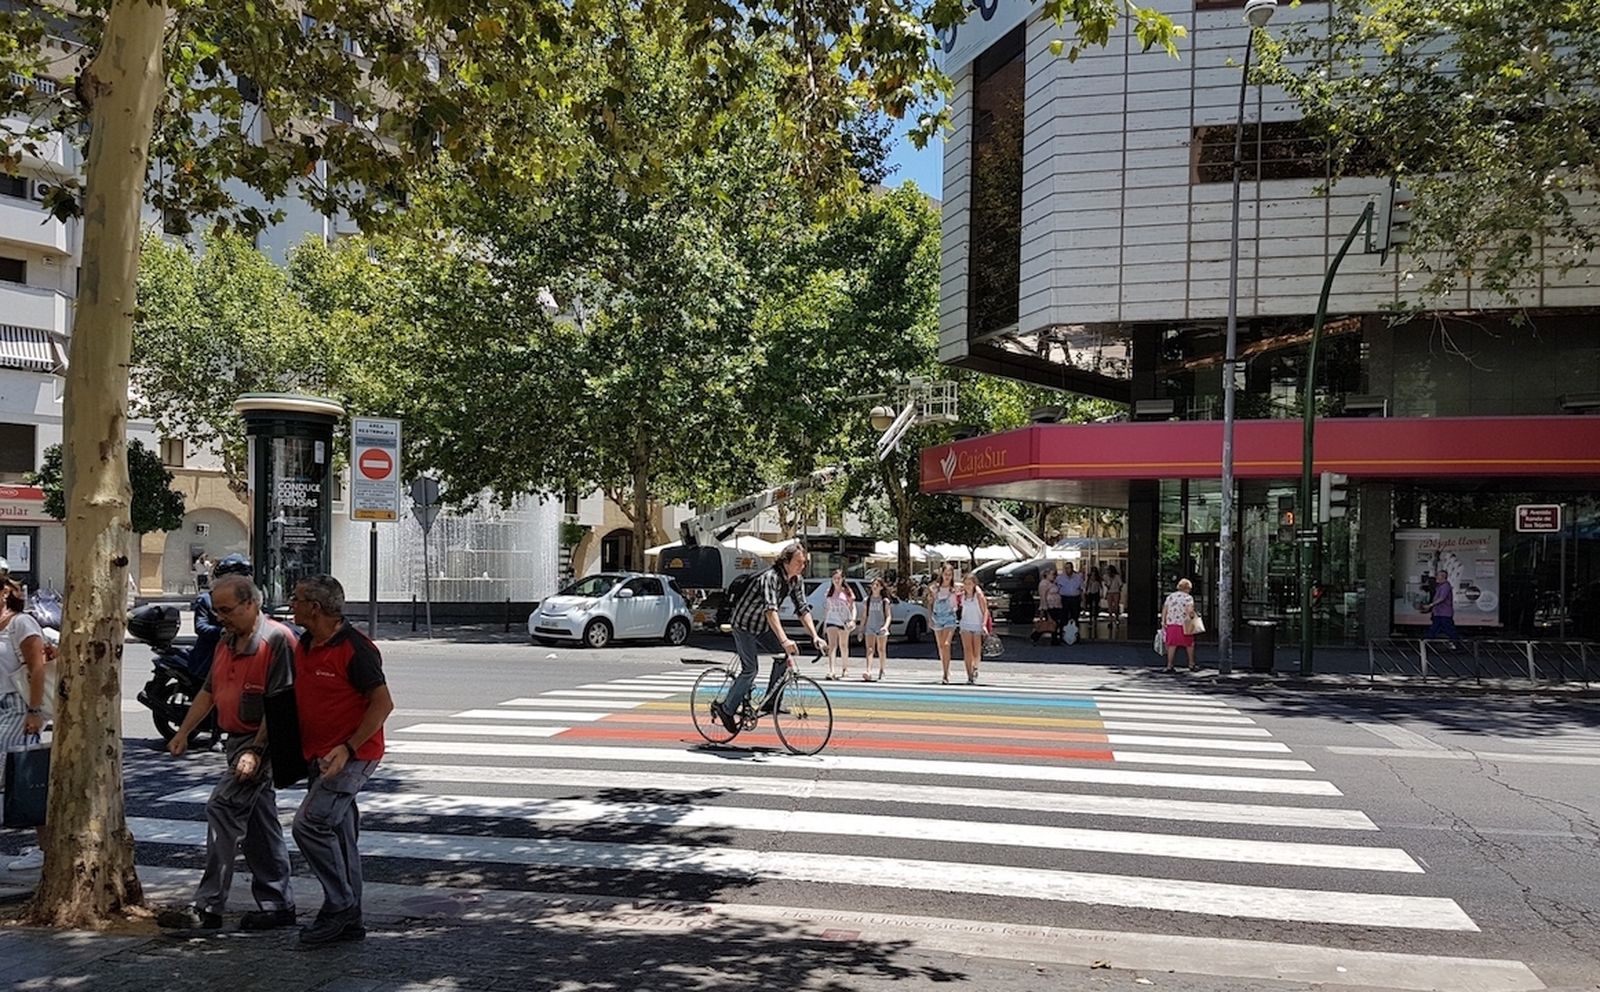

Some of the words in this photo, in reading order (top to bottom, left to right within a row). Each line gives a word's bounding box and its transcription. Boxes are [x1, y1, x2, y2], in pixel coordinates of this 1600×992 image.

[958, 445, 1008, 477] CajaSur
[277, 482, 321, 493] CONDUCE
[277, 490, 307, 499] COMO
[277, 498, 318, 508] PIENSAS
[780, 910, 866, 924] Hospital
[869, 917, 995, 934] Universitario
